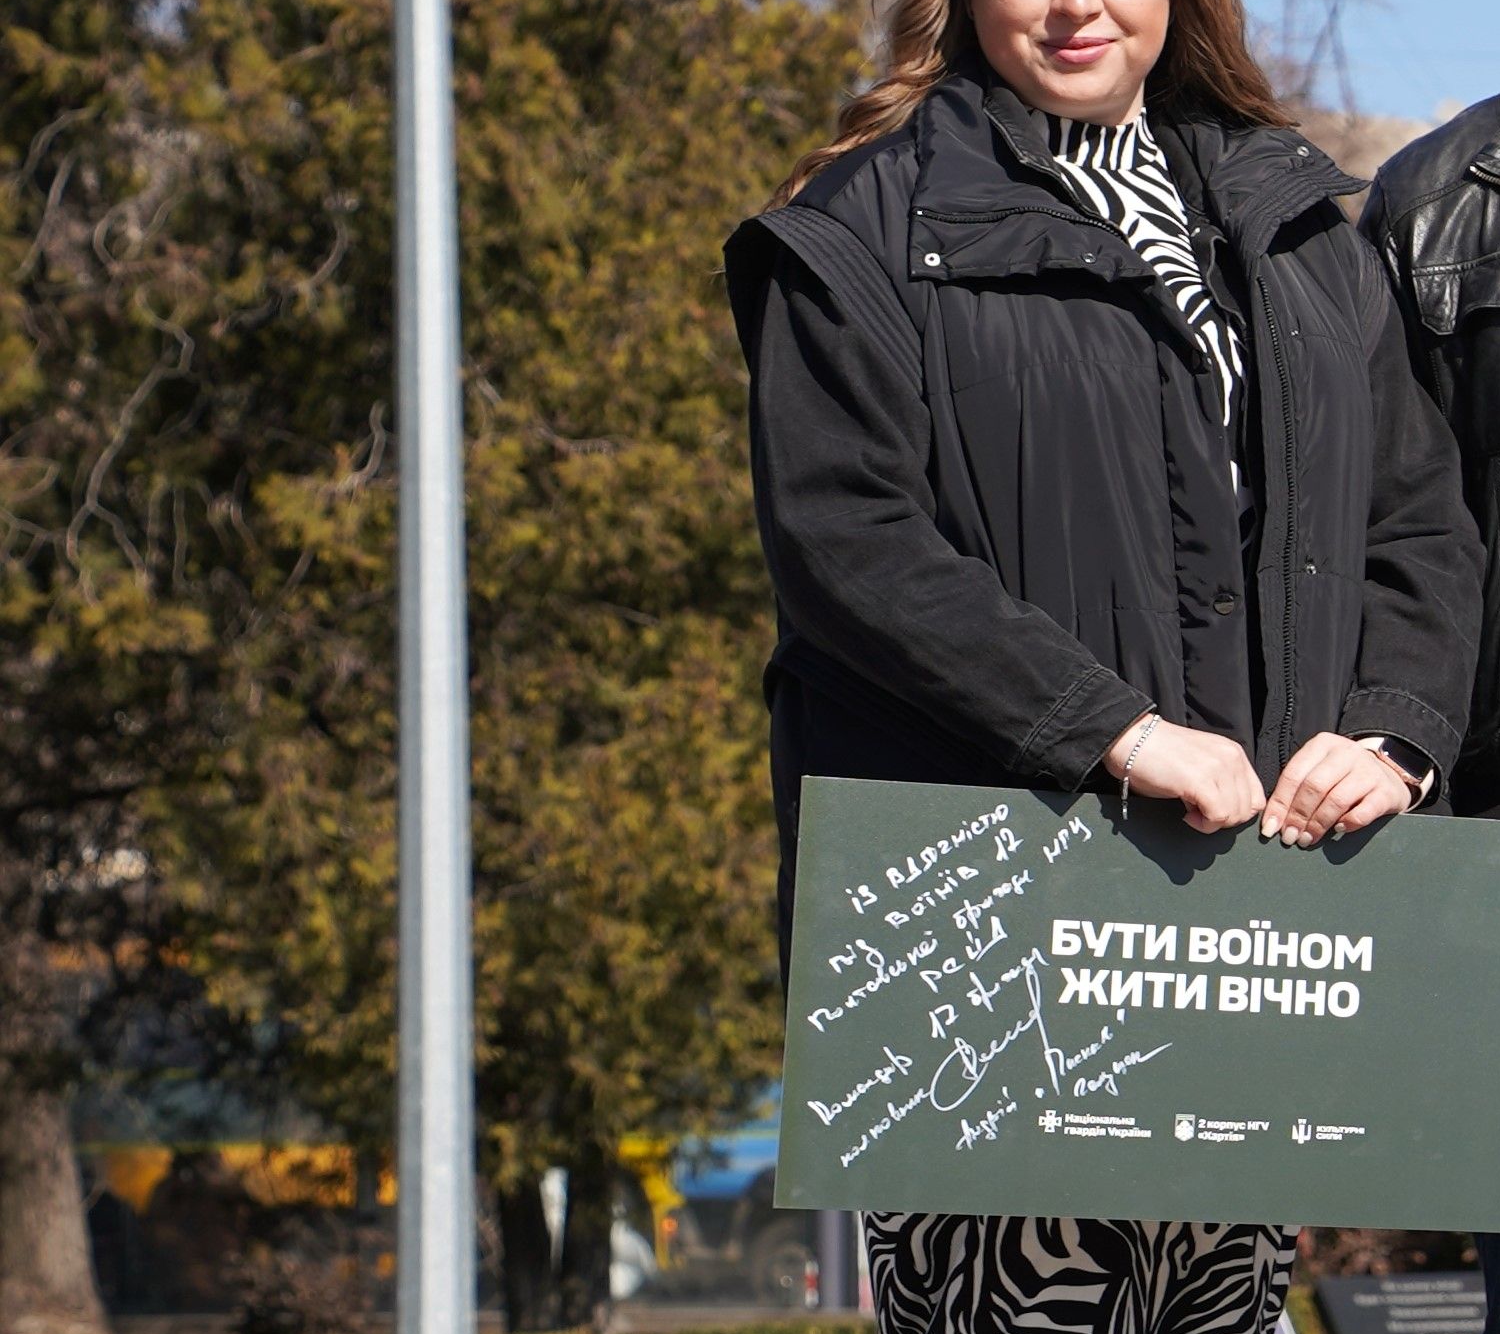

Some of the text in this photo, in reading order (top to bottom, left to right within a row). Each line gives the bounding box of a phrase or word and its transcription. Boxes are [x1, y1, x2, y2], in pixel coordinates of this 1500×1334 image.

[1051, 919, 1374, 972] БУТИ ВОЇНОМ
[1058, 967, 1361, 1019] ЖИТИ ВІЧНО
[1064, 1113, 1136, 1126] Національна
[1198, 1118, 1270, 1133] 2 корпус НГУ
[1063, 1126, 1152, 1139] гвардія України
